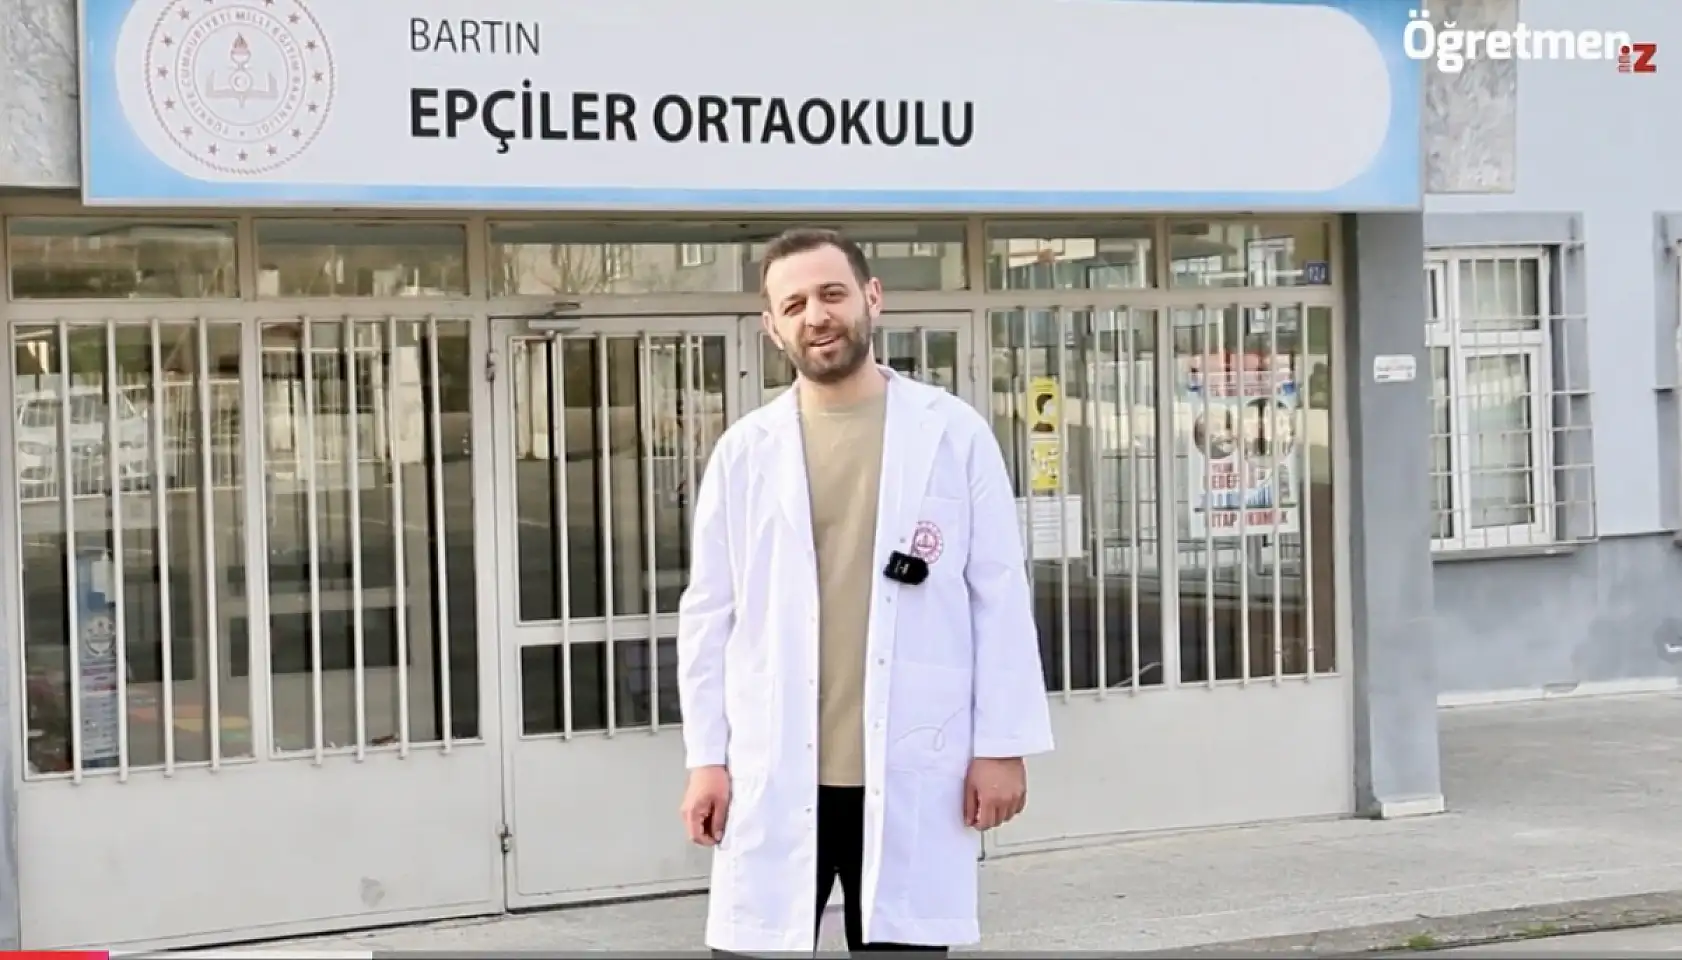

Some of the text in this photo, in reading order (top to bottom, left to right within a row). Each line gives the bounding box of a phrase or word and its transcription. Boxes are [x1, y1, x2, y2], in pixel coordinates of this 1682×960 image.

[410, 17, 540, 55] BARTIN
[410, 78, 975, 154] EPÇİLER ORTAOKULU
